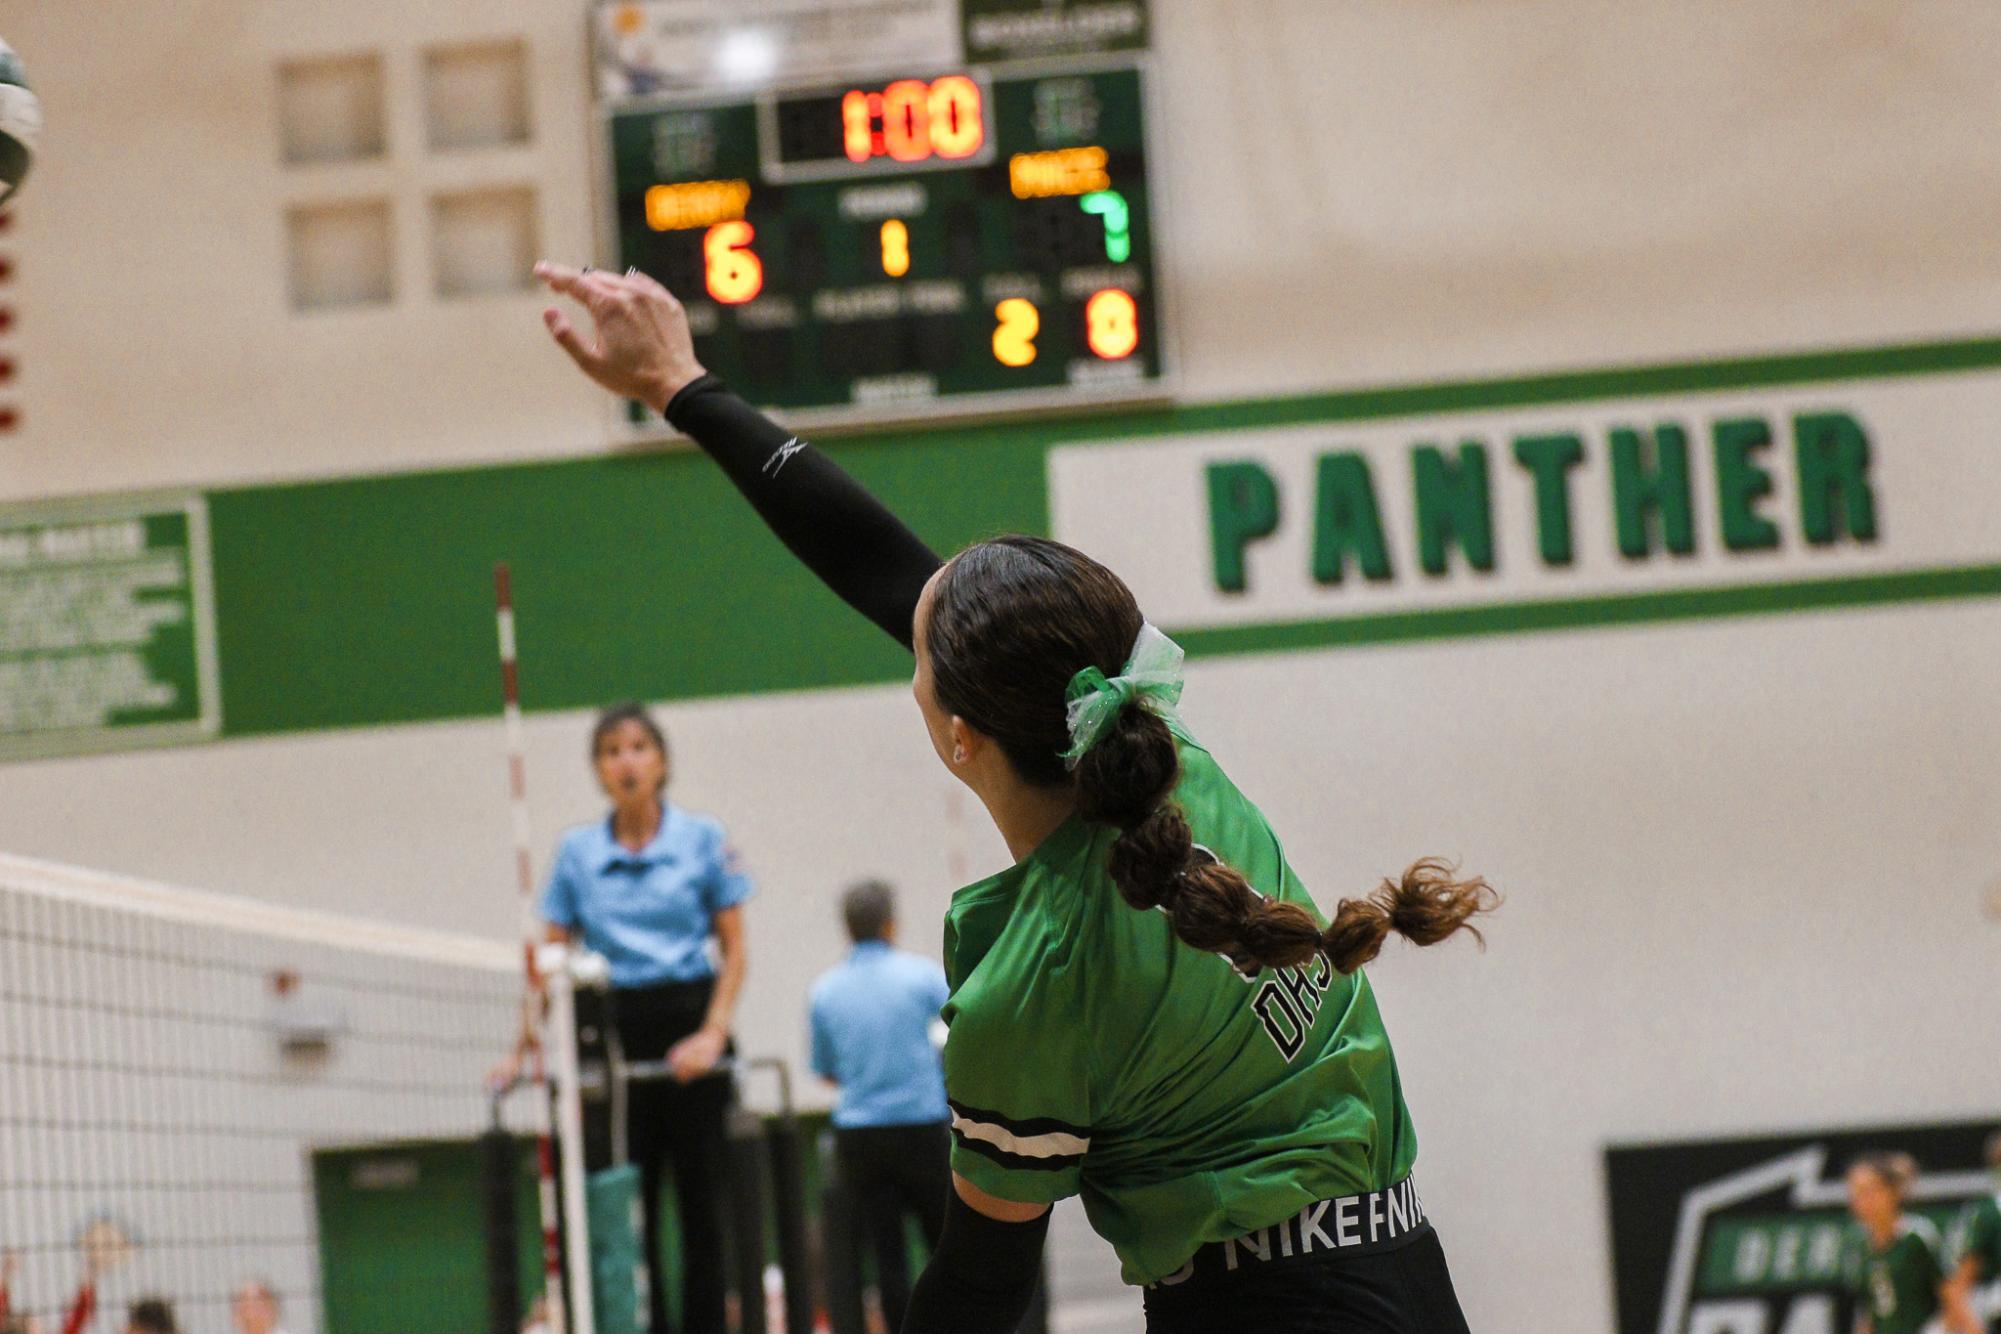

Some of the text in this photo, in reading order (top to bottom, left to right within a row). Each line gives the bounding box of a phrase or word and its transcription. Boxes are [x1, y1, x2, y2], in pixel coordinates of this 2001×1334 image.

[842, 74, 984, 163] 1:00
[704, 220, 763, 305] 6
[880, 217, 910, 278] 1
[1079, 189, 1130, 262] 7
[992, 297, 1039, 367] 2
[1206, 411, 1880, 593] PANTHER
[1223, 1196, 1362, 1271] NIKE
